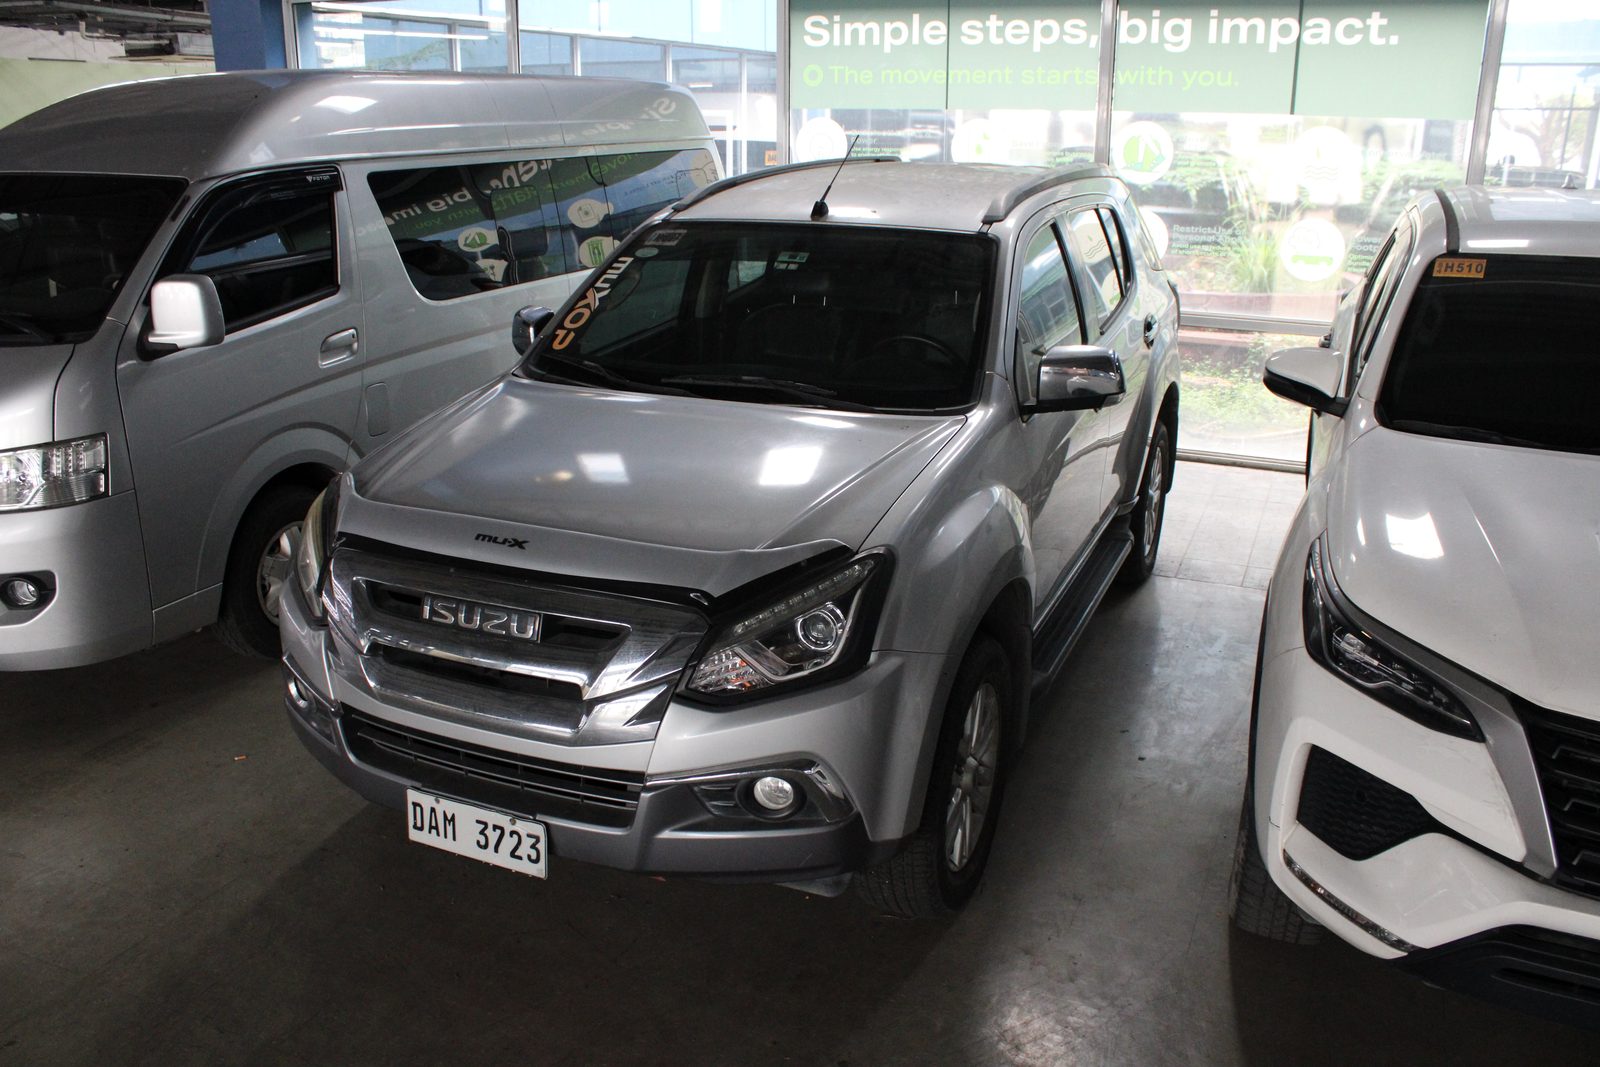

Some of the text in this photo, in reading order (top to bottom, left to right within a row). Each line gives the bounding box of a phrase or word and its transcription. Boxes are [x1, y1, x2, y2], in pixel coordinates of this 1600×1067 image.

[803, 9, 1399, 53] Simple steps, big impact.
[829, 65, 1239, 91] The movement starts with you.
[422, 596, 536, 639] ISUZU
[412, 801, 541, 864] DAM 3723
